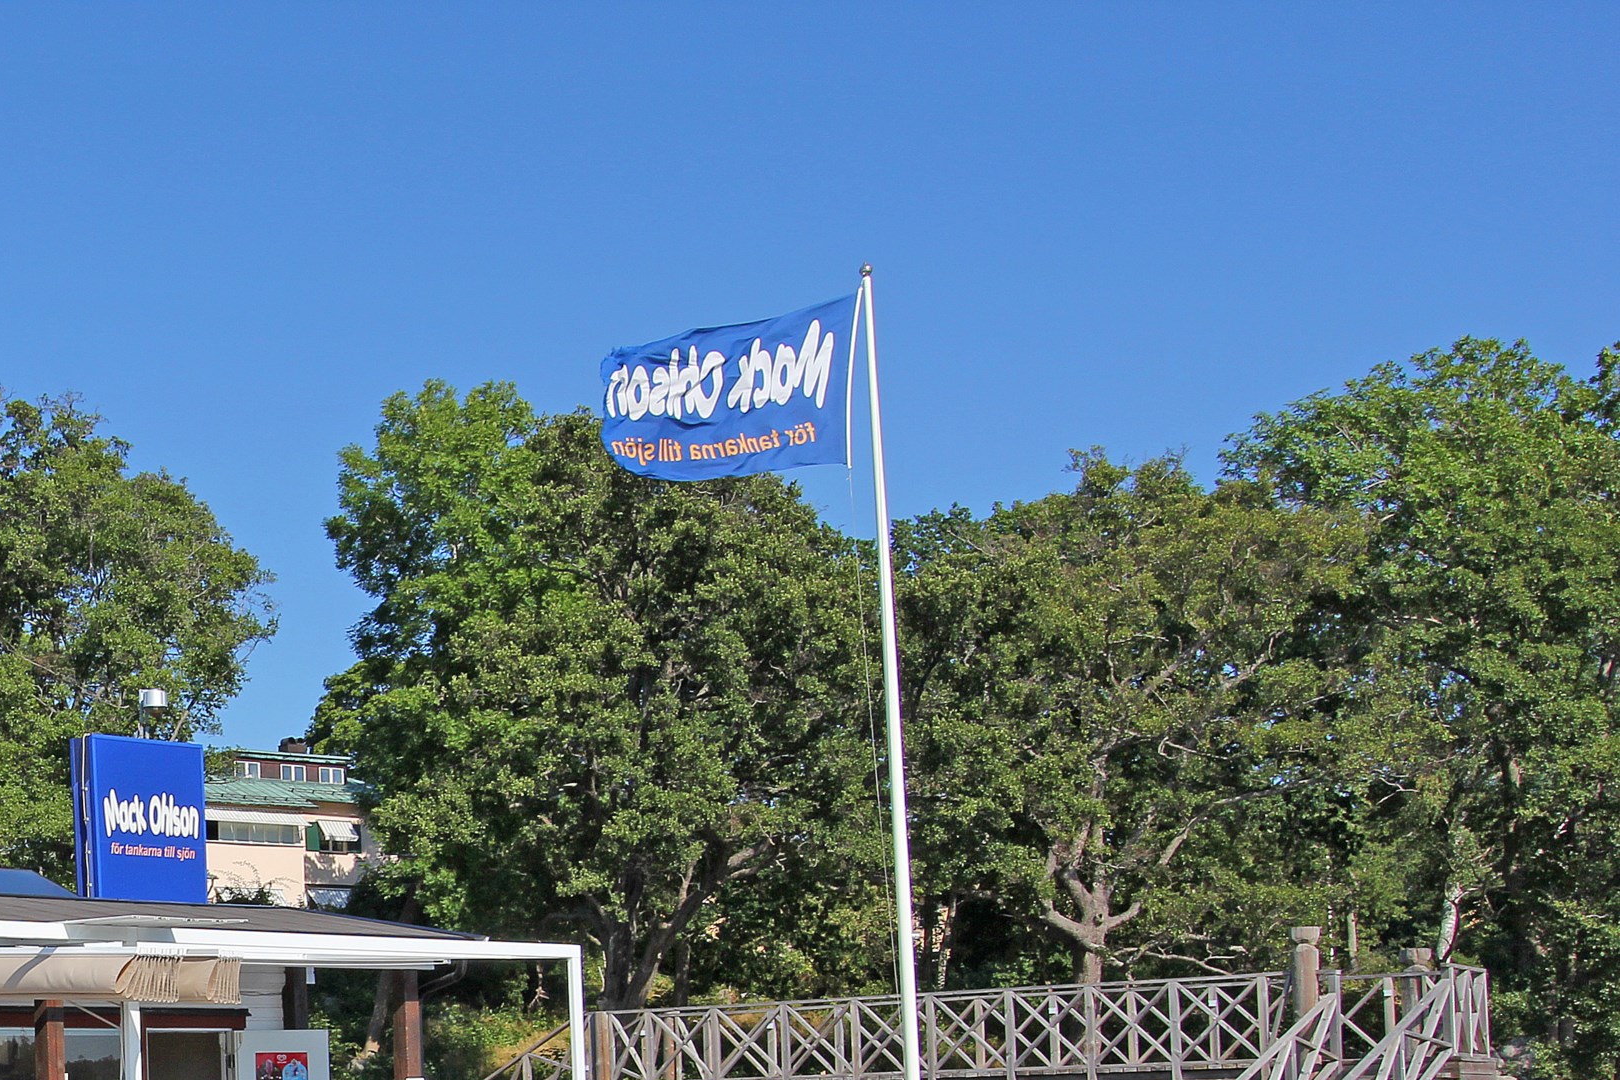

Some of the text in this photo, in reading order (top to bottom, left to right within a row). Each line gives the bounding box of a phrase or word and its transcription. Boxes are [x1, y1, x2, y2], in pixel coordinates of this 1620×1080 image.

[103, 788, 200, 840] Mack Ohlson
[110, 842, 196, 862] för tankarna till sjön
